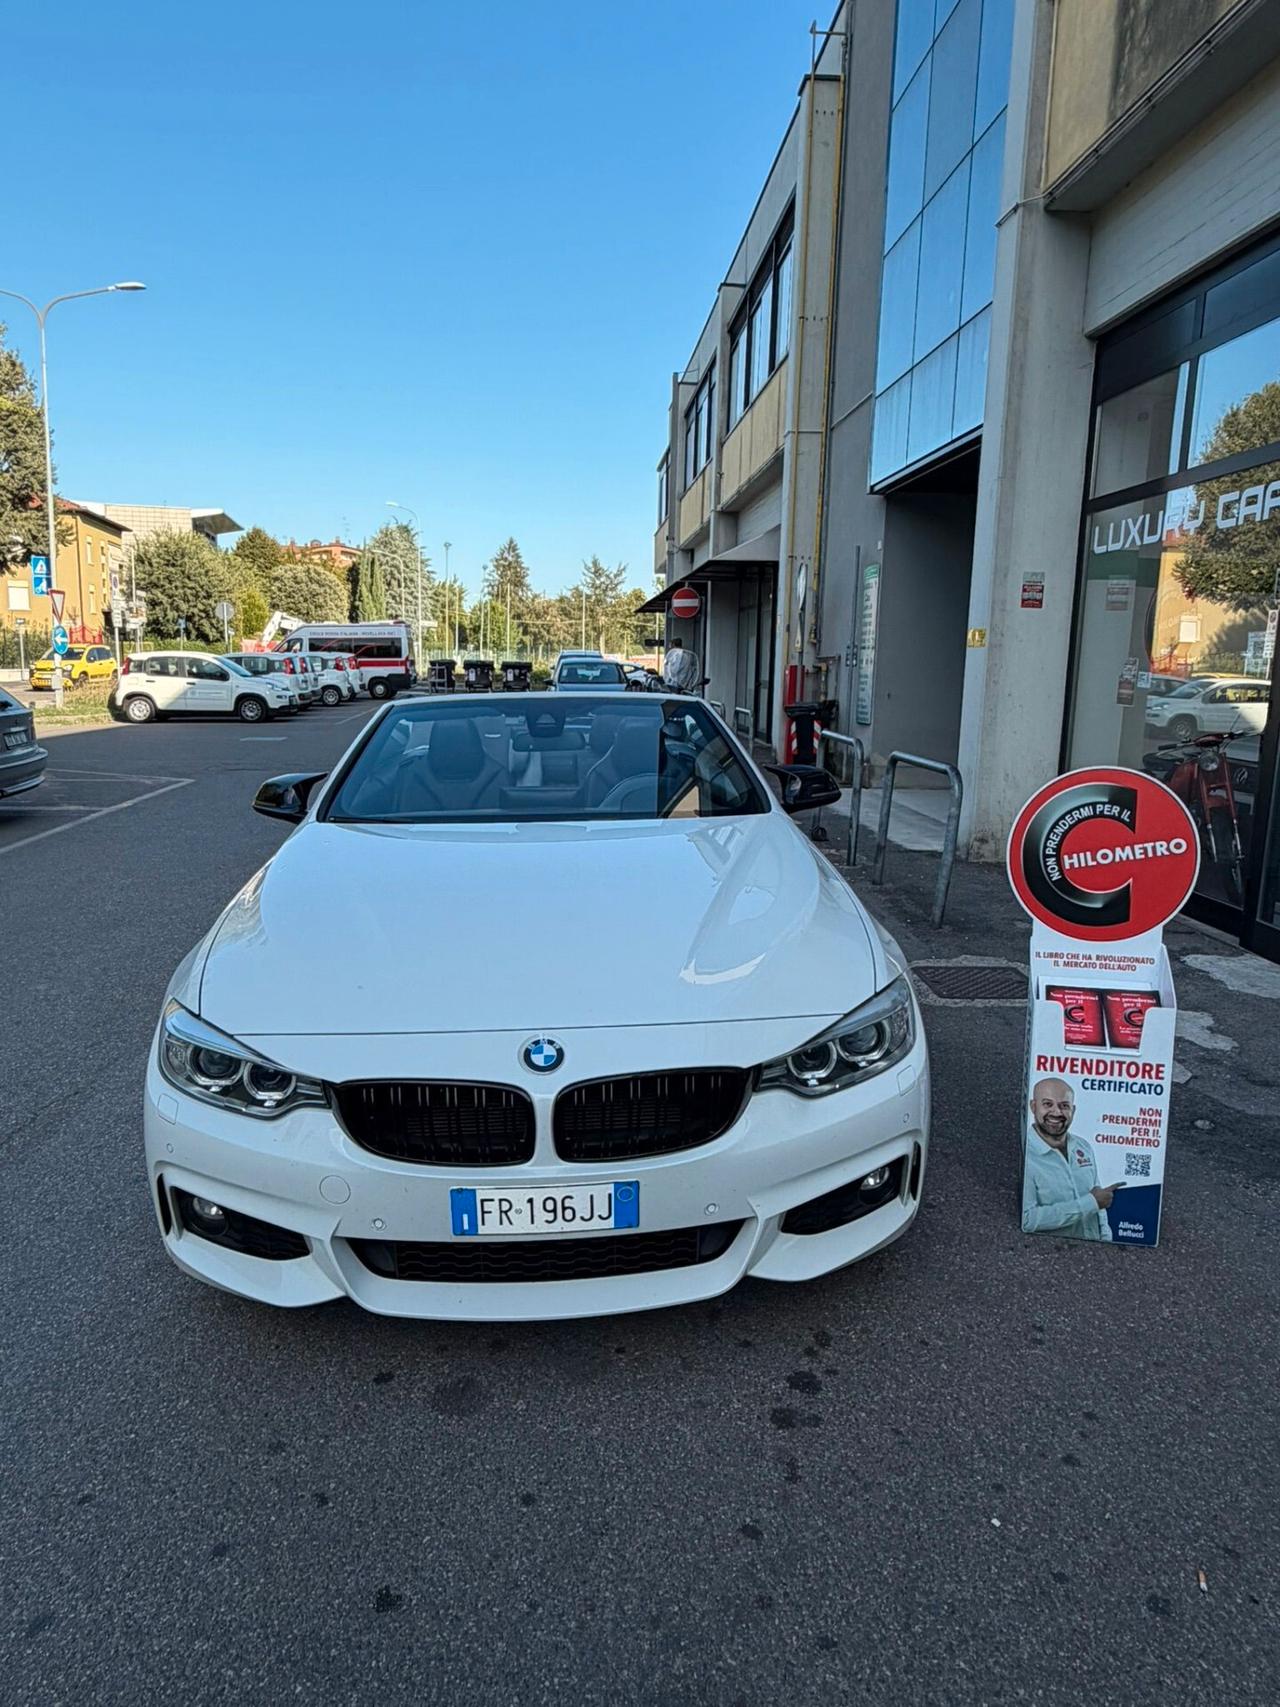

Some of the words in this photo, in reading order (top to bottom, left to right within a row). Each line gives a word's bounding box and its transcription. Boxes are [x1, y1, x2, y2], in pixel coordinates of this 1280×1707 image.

[1093, 500, 1206, 555] LUXURY
[1096, 804, 1120, 817] PER
[1120, 809, 1131, 822] IL
[1045, 805, 1093, 855] PRENDERMI
[1045, 857, 1062, 881] NON
[1035, 951, 1042, 959] IL
[1043, 952, 1065, 960] LIBRO
[1095, 954, 1155, 965] RIVOLUZIONATO
[1063, 960, 1097, 970] MERCATO
[1099, 963, 1137, 972] DELL'AUTO
[1036, 1055, 1165, 1080] RIVENDITORE
[1081, 1078, 1164, 1096] CERTIFICATO
[1139, 1107, 1163, 1118] NON
[1102, 1114, 1161, 1128] PRENDERMI
[1131, 1127, 1149, 1137] PER
[1095, 1134, 1160, 1148] CHILOMETRO
